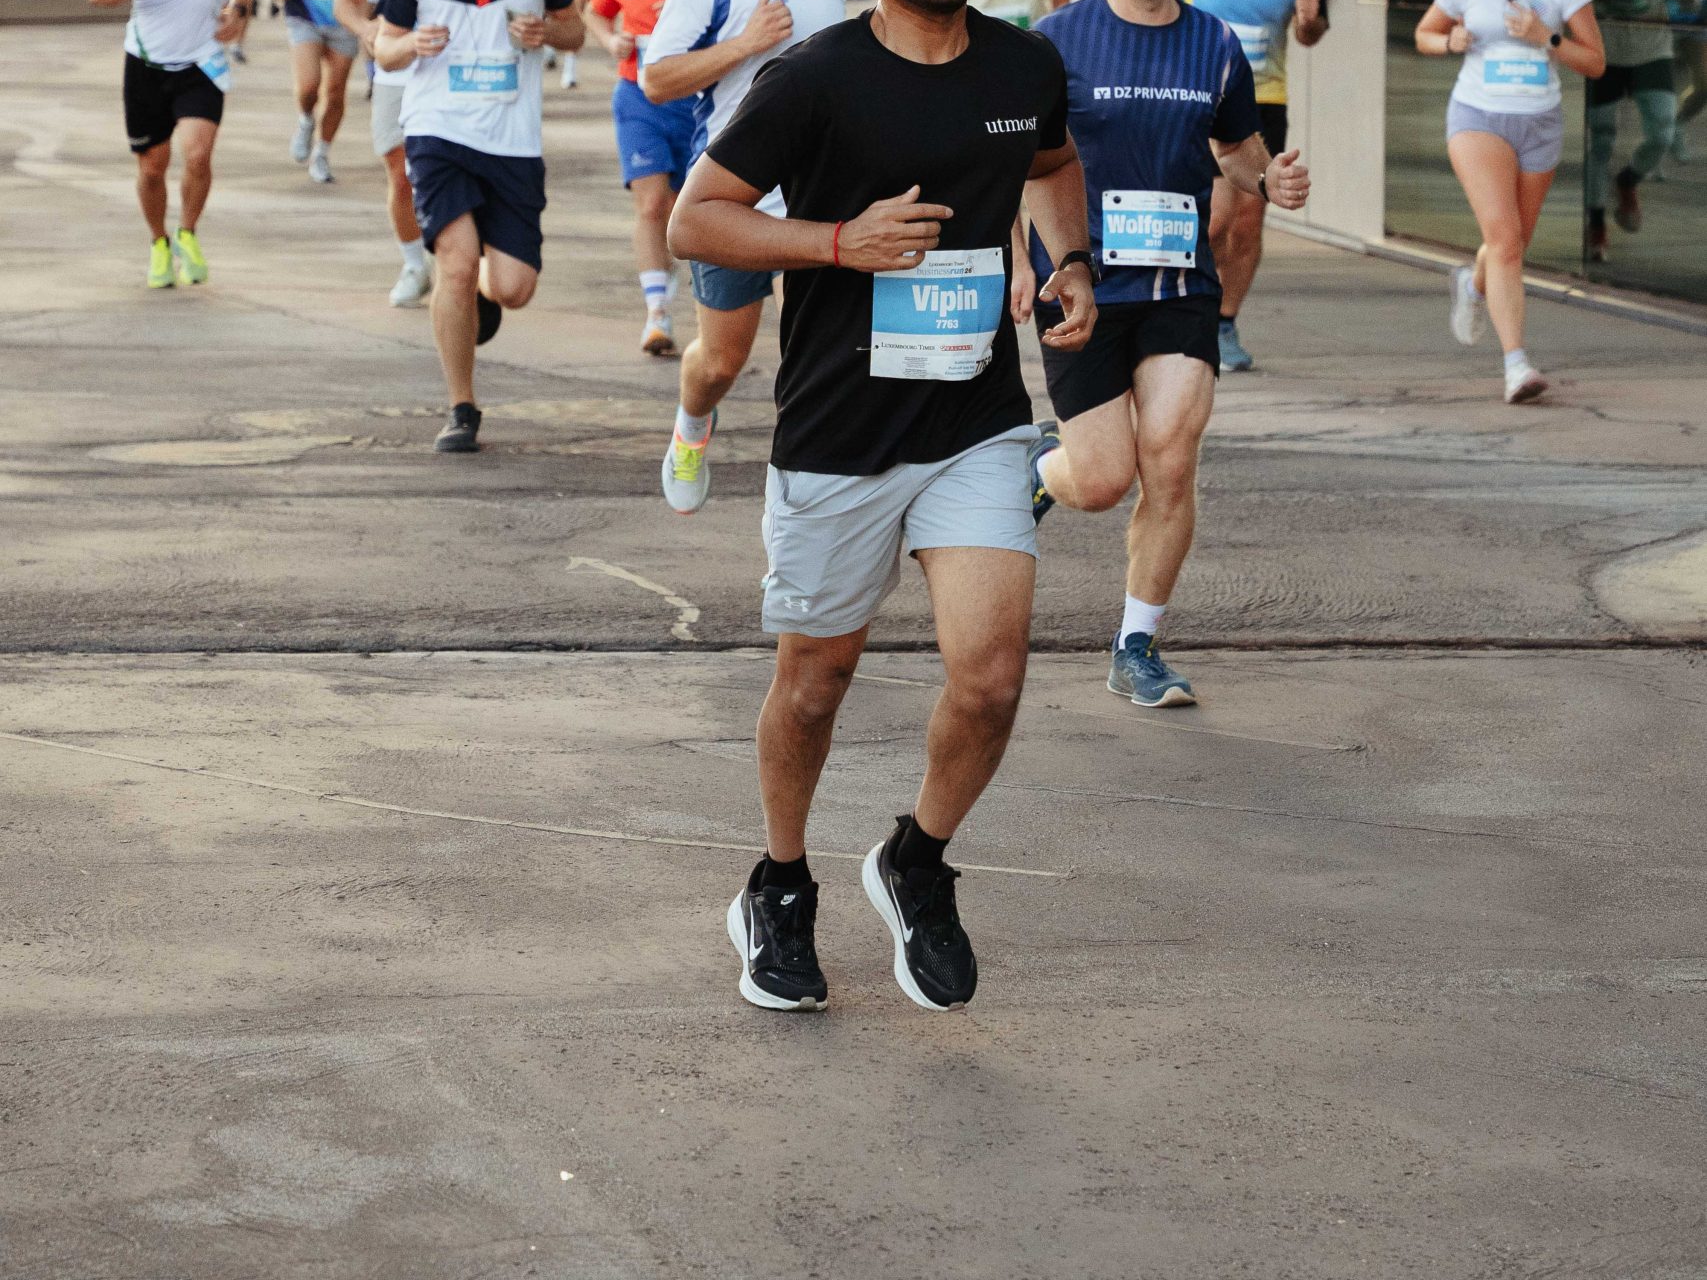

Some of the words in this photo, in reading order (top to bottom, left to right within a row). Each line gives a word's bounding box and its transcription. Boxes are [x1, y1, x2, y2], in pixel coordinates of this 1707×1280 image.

[1114, 86, 1132, 98] DZ
[1134, 87, 1213, 104] PRIVATBANK
[985, 116, 1038, 133] utmost
[1106, 214, 1194, 240] Wolfgang
[912, 284, 978, 318] Vipin
[935, 320, 958, 329] 7763
[881, 341, 918, 350] LUXEMBOURG
